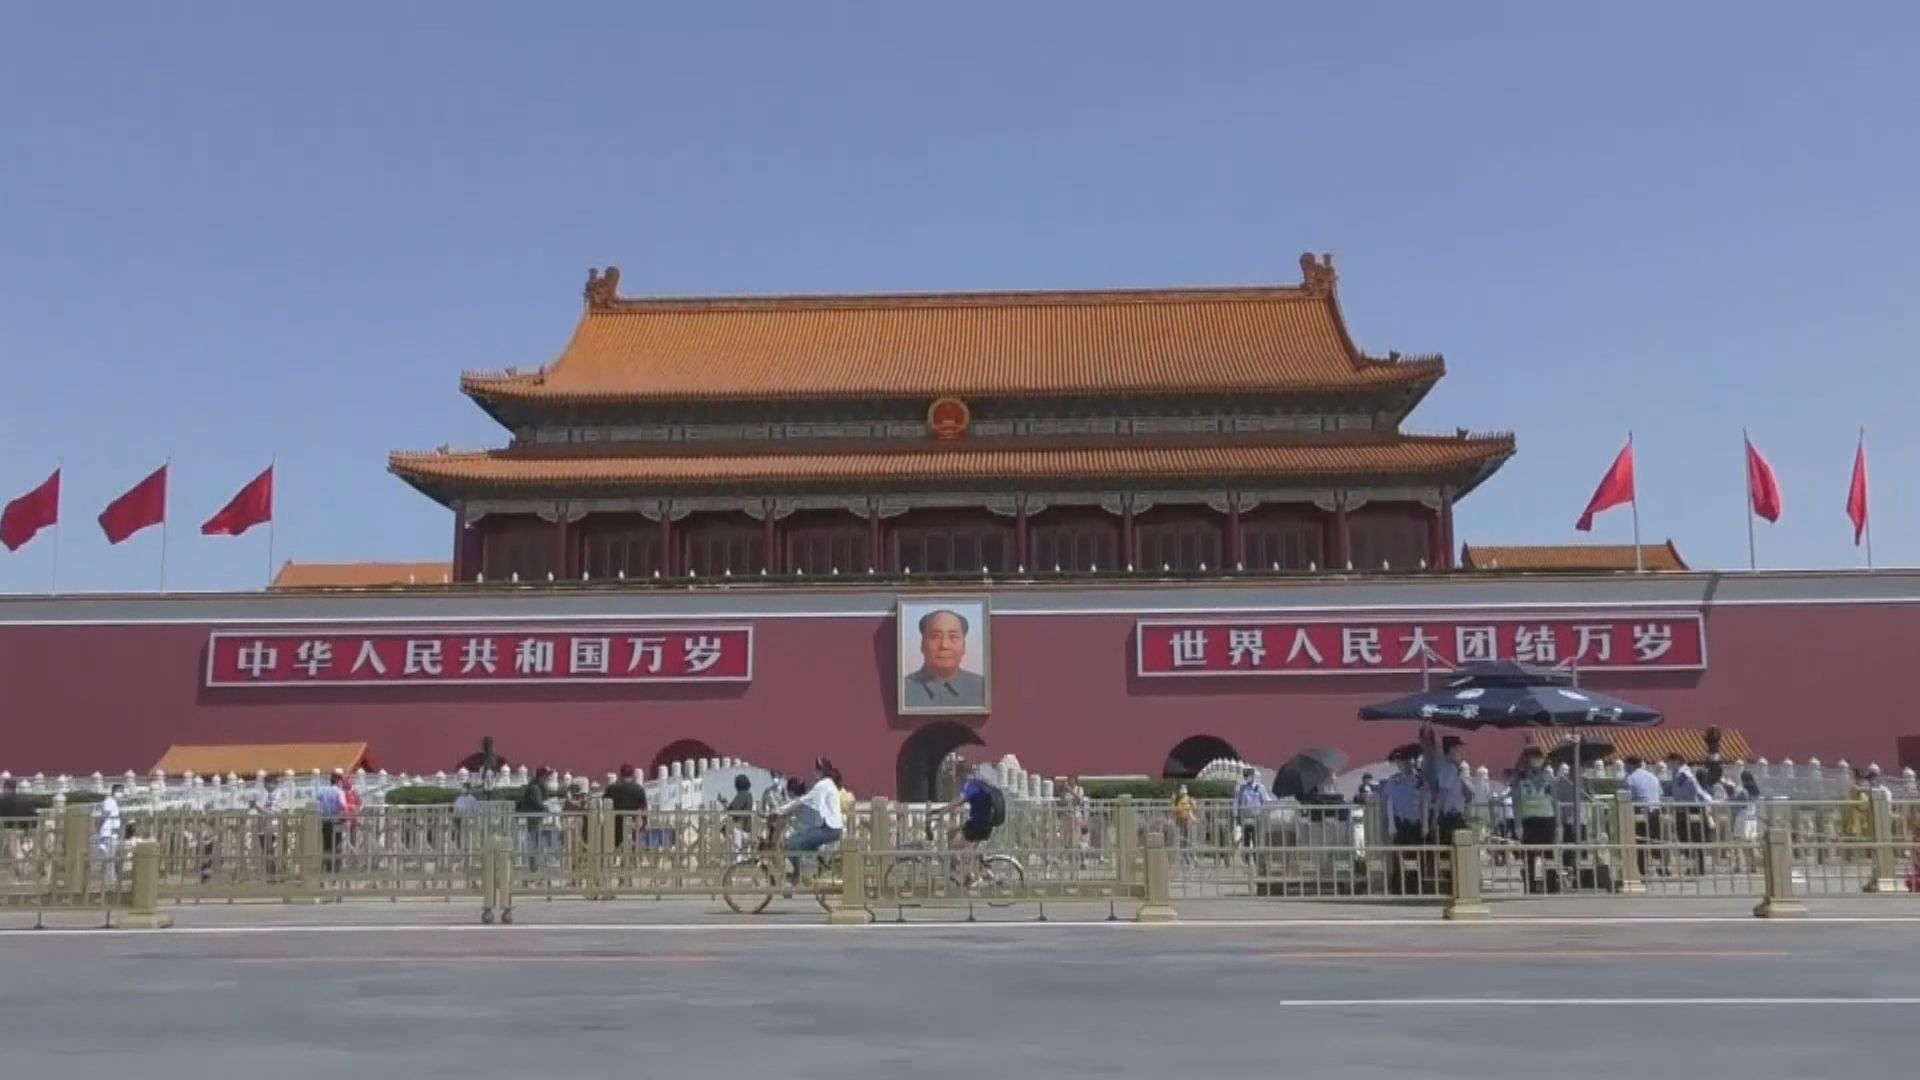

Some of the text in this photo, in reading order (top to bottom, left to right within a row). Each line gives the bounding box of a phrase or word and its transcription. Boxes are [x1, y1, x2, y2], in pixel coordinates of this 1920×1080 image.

[237, 636, 722, 677] 中华人民共和国万岁
[1170, 624, 1675, 666] 世界人民大团结万岁
